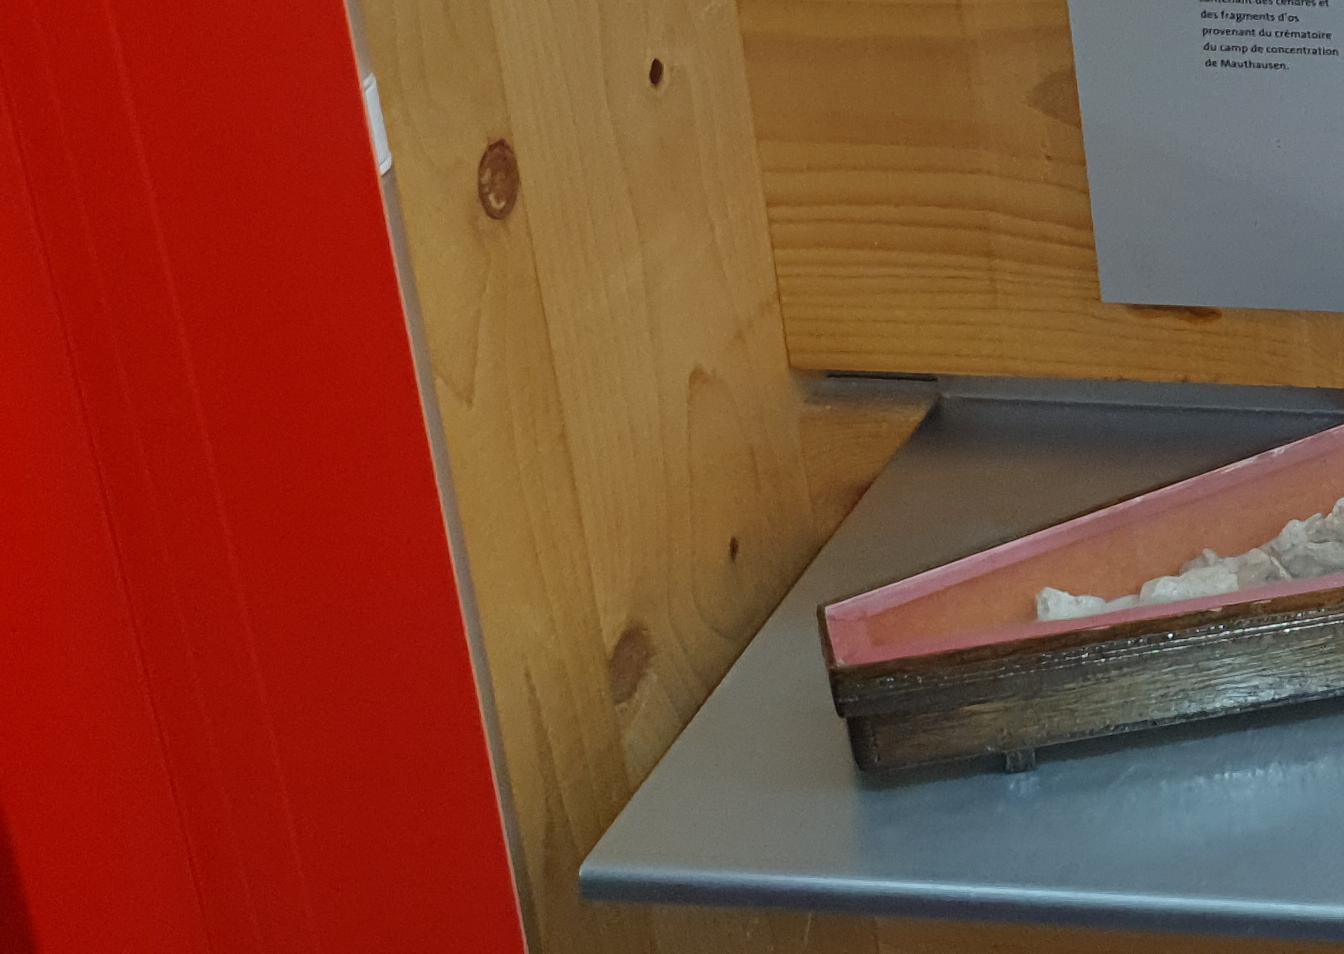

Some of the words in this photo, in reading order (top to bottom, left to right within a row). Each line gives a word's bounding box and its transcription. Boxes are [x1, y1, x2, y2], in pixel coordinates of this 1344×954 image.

[1319, 0, 1329, 7] et
[1201, 10, 1219, 19] des
[1221, 11, 1275, 23] fragments
[1278, 13, 1300, 23] d'os
[1202, 28, 1256, 38] provenant
[1259, 29, 1272, 38] du
[1275, 30, 1332, 40] crématoire
[1203, 42, 1217, 52] du
[1220, 45, 1248, 55] camp
[1250, 45, 1264, 54] de
[1266, 47, 1339, 56] concentration
[1205, 59, 1218, 68] de
